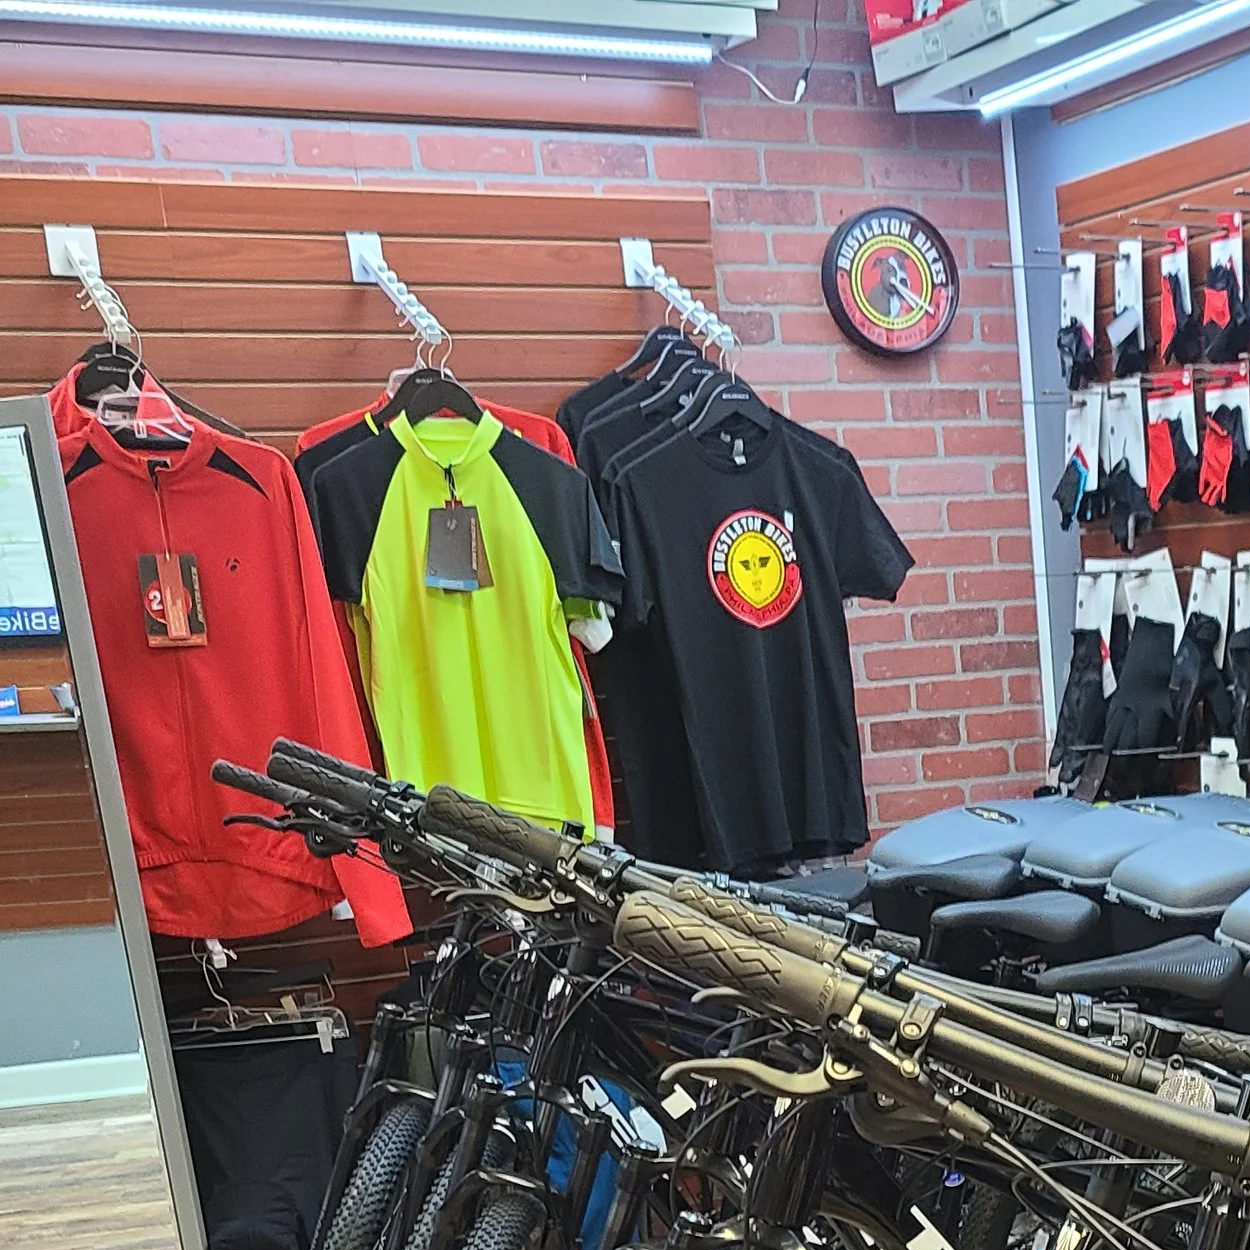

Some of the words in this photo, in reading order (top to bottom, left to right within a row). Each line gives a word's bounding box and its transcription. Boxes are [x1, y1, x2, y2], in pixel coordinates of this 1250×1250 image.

[837, 217, 912, 272] BUSTLETON
[912, 230, 947, 285] BIKES
[713, 516, 762, 573] BUSTLETON
[764, 523, 797, 563] BIKES
